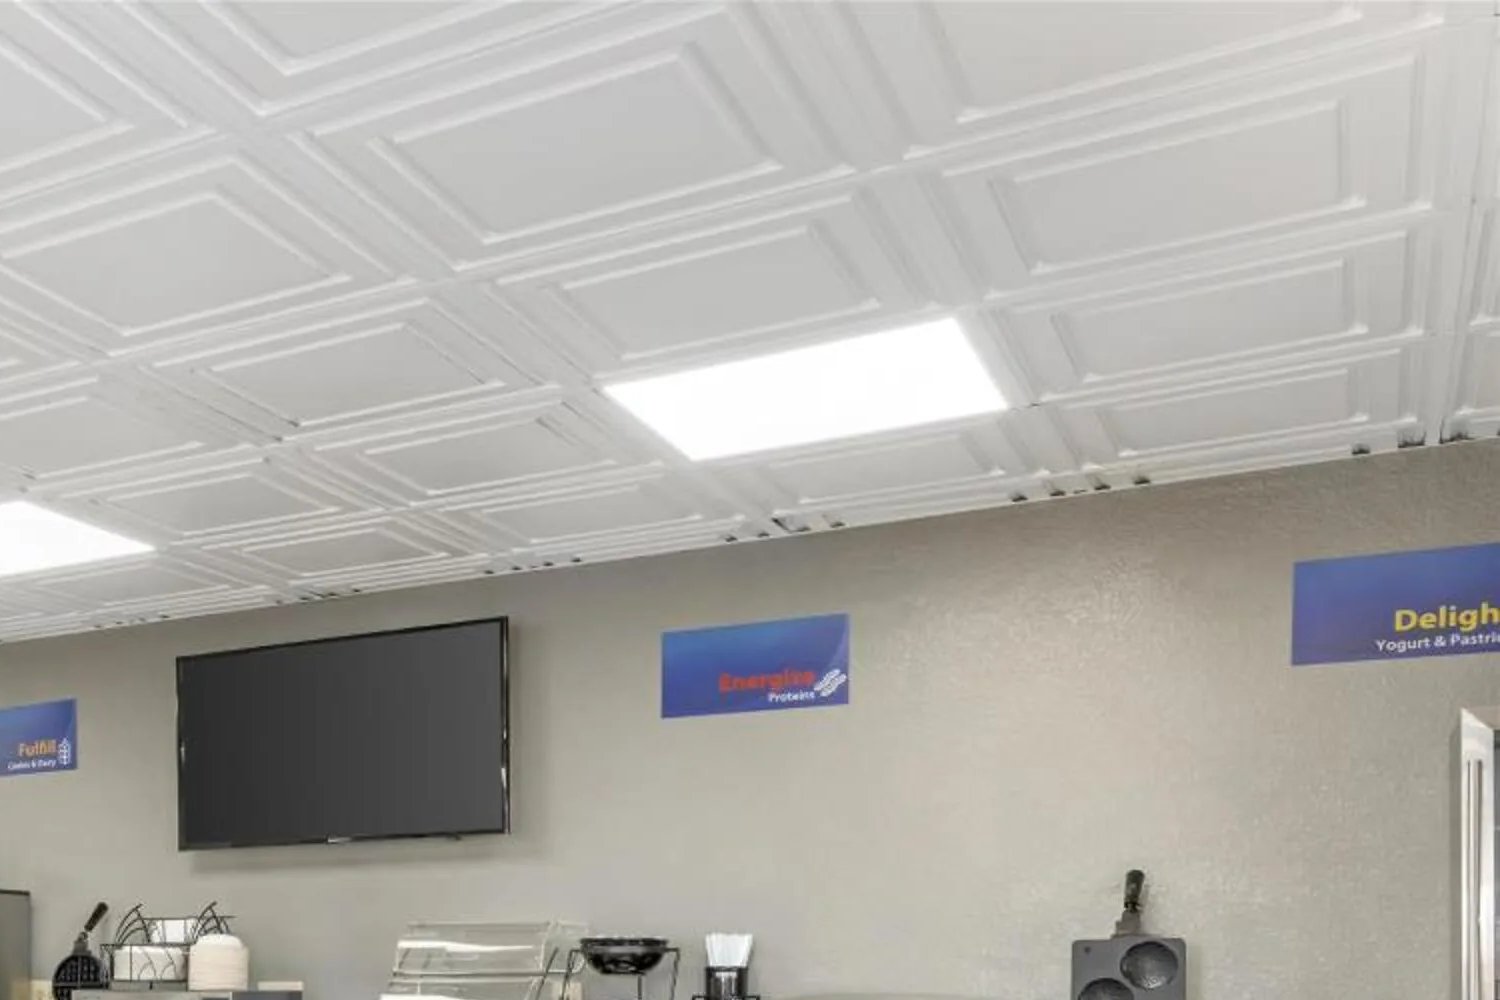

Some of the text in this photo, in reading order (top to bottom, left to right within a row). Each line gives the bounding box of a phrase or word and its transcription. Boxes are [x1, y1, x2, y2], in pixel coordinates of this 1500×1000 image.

[1395, 602, 1500, 632] Deligh
[1375, 637, 1430, 653] Yogurt
[1433, 635, 1447, 647] &
[718, 669, 815, 693] Energize
[768, 690, 815, 703] Proteins
